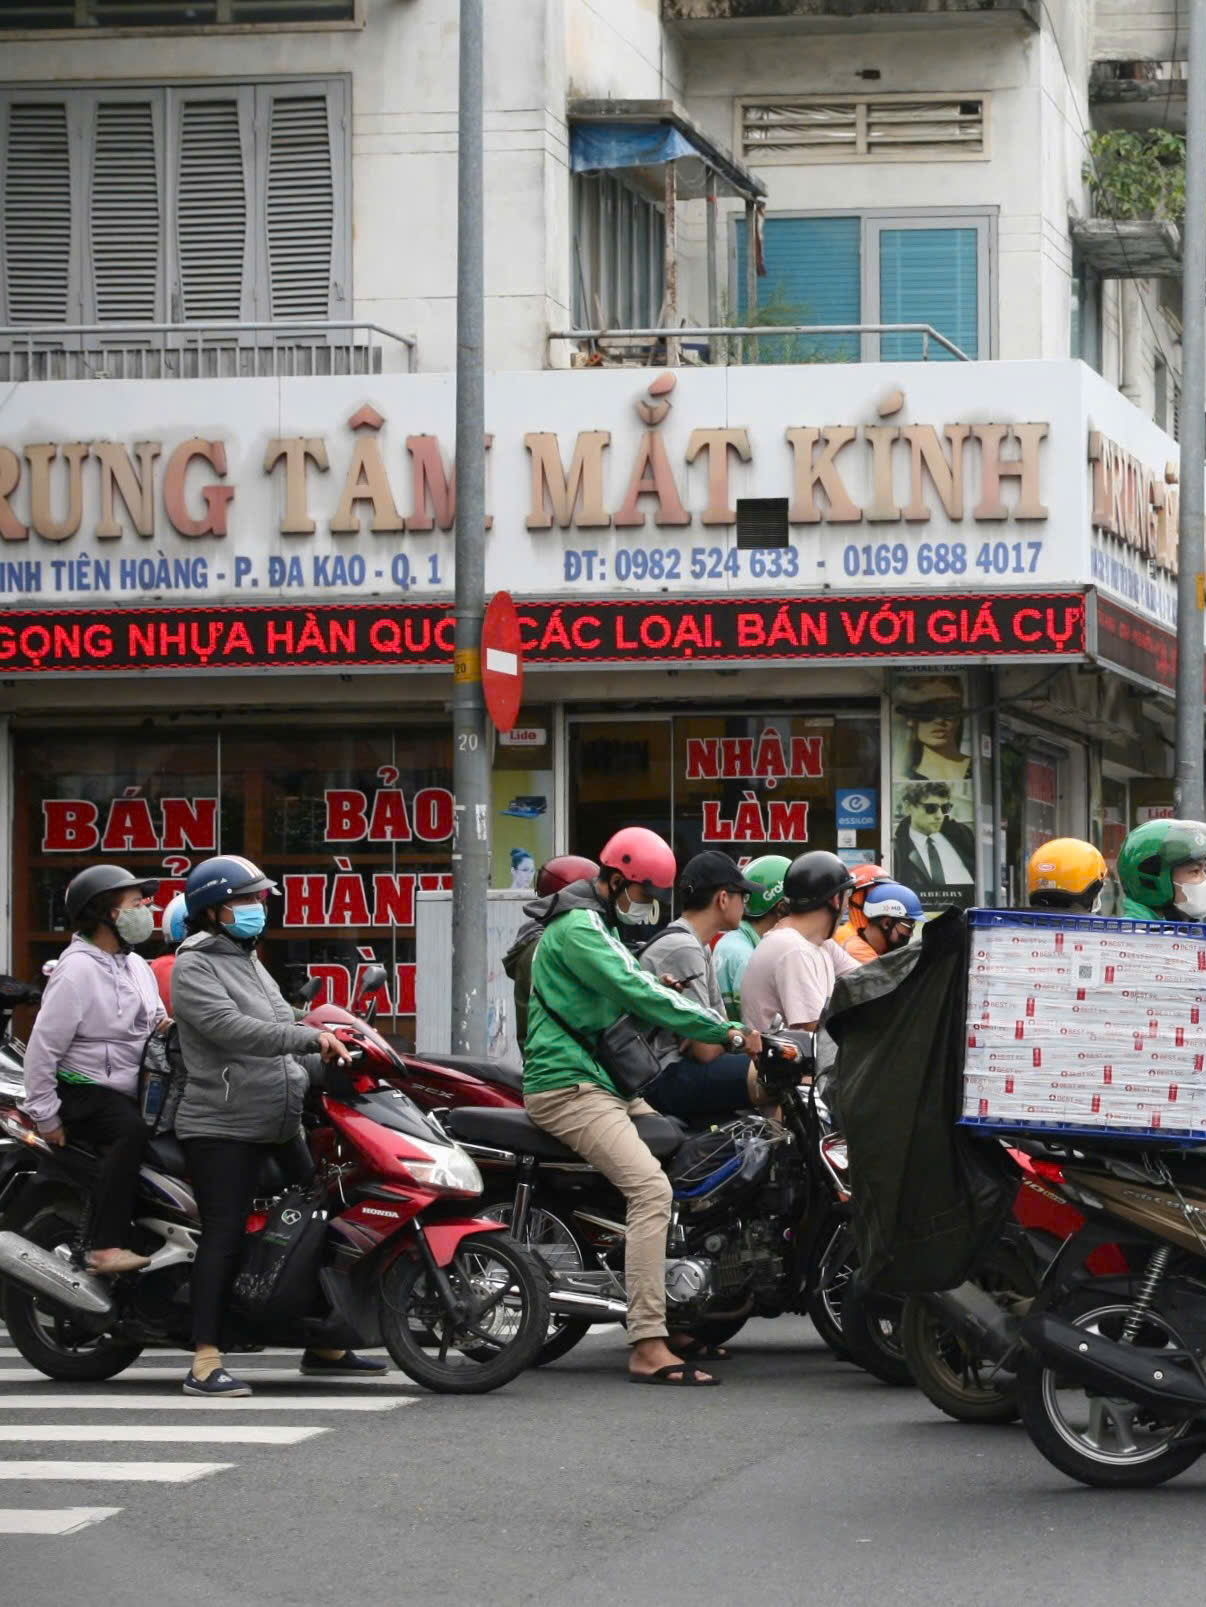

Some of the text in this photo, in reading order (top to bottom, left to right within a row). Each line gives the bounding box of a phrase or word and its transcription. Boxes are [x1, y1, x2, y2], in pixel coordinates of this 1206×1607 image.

[263, 403, 494, 534] TÂM
[523, 371, 753, 530] MẮT
[786, 389, 1050, 524] KÍNH
[51, 552, 108, 592] TIÊN
[120, 549, 208, 591] HOÀNG
[234, 556, 258, 588] P.
[312, 554, 367, 586] KAO
[391, 552, 418, 588] Q.
[428, 553, 442, 585] 1
[563, 550, 608, 581] ĐT:
[615, 547, 682, 580] 0982
[690, 546, 740, 578] 524
[749, 545, 800, 578] 633
[843, 543, 909, 577] 0169
[915, 542, 969, 576] 688
[975, 541, 1043, 576] 4017
[129, 618, 254, 669] NHỰA
[266, 610, 356, 656] HÀN
[736, 606, 828, 649] BÁN
[840, 604, 915, 646] VỚI
[928, 602, 1002, 644] GIÁ
[457, 733, 479, 752] 20
[686, 728, 824, 790] NHẬN
[41, 785, 218, 853] BÁN
[324, 765, 455, 843] BẢO
[701, 792, 808, 842] LÀM
[283, 856, 453, 928] HÀN
[362, 1207, 399, 1218] HONDA
